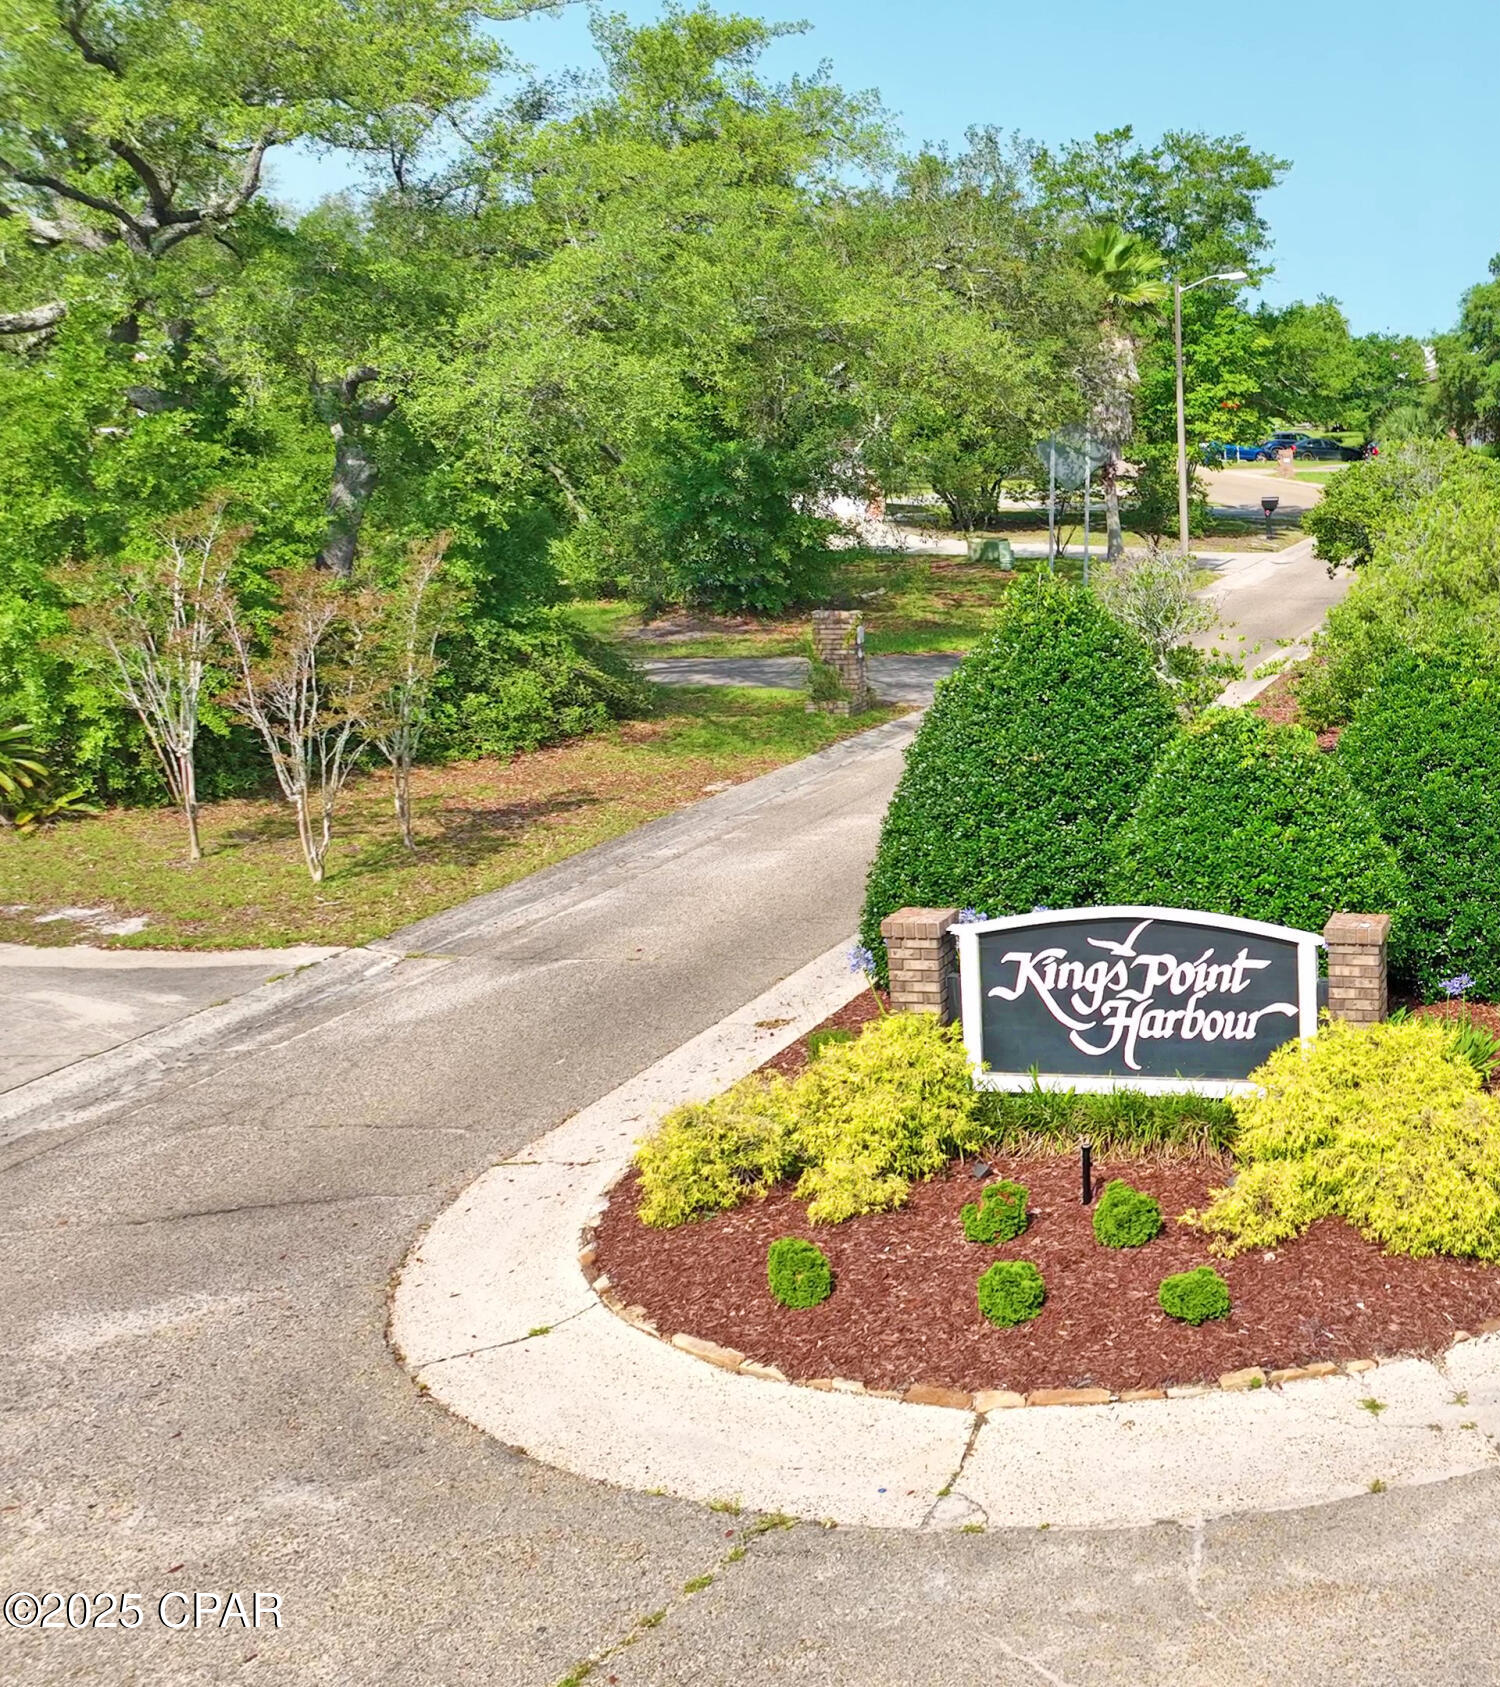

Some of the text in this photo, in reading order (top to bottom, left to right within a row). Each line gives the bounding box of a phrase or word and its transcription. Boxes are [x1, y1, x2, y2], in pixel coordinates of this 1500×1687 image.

[988, 947, 1272, 1031] Kings Point
[1070, 990, 1299, 1071] Harbour
